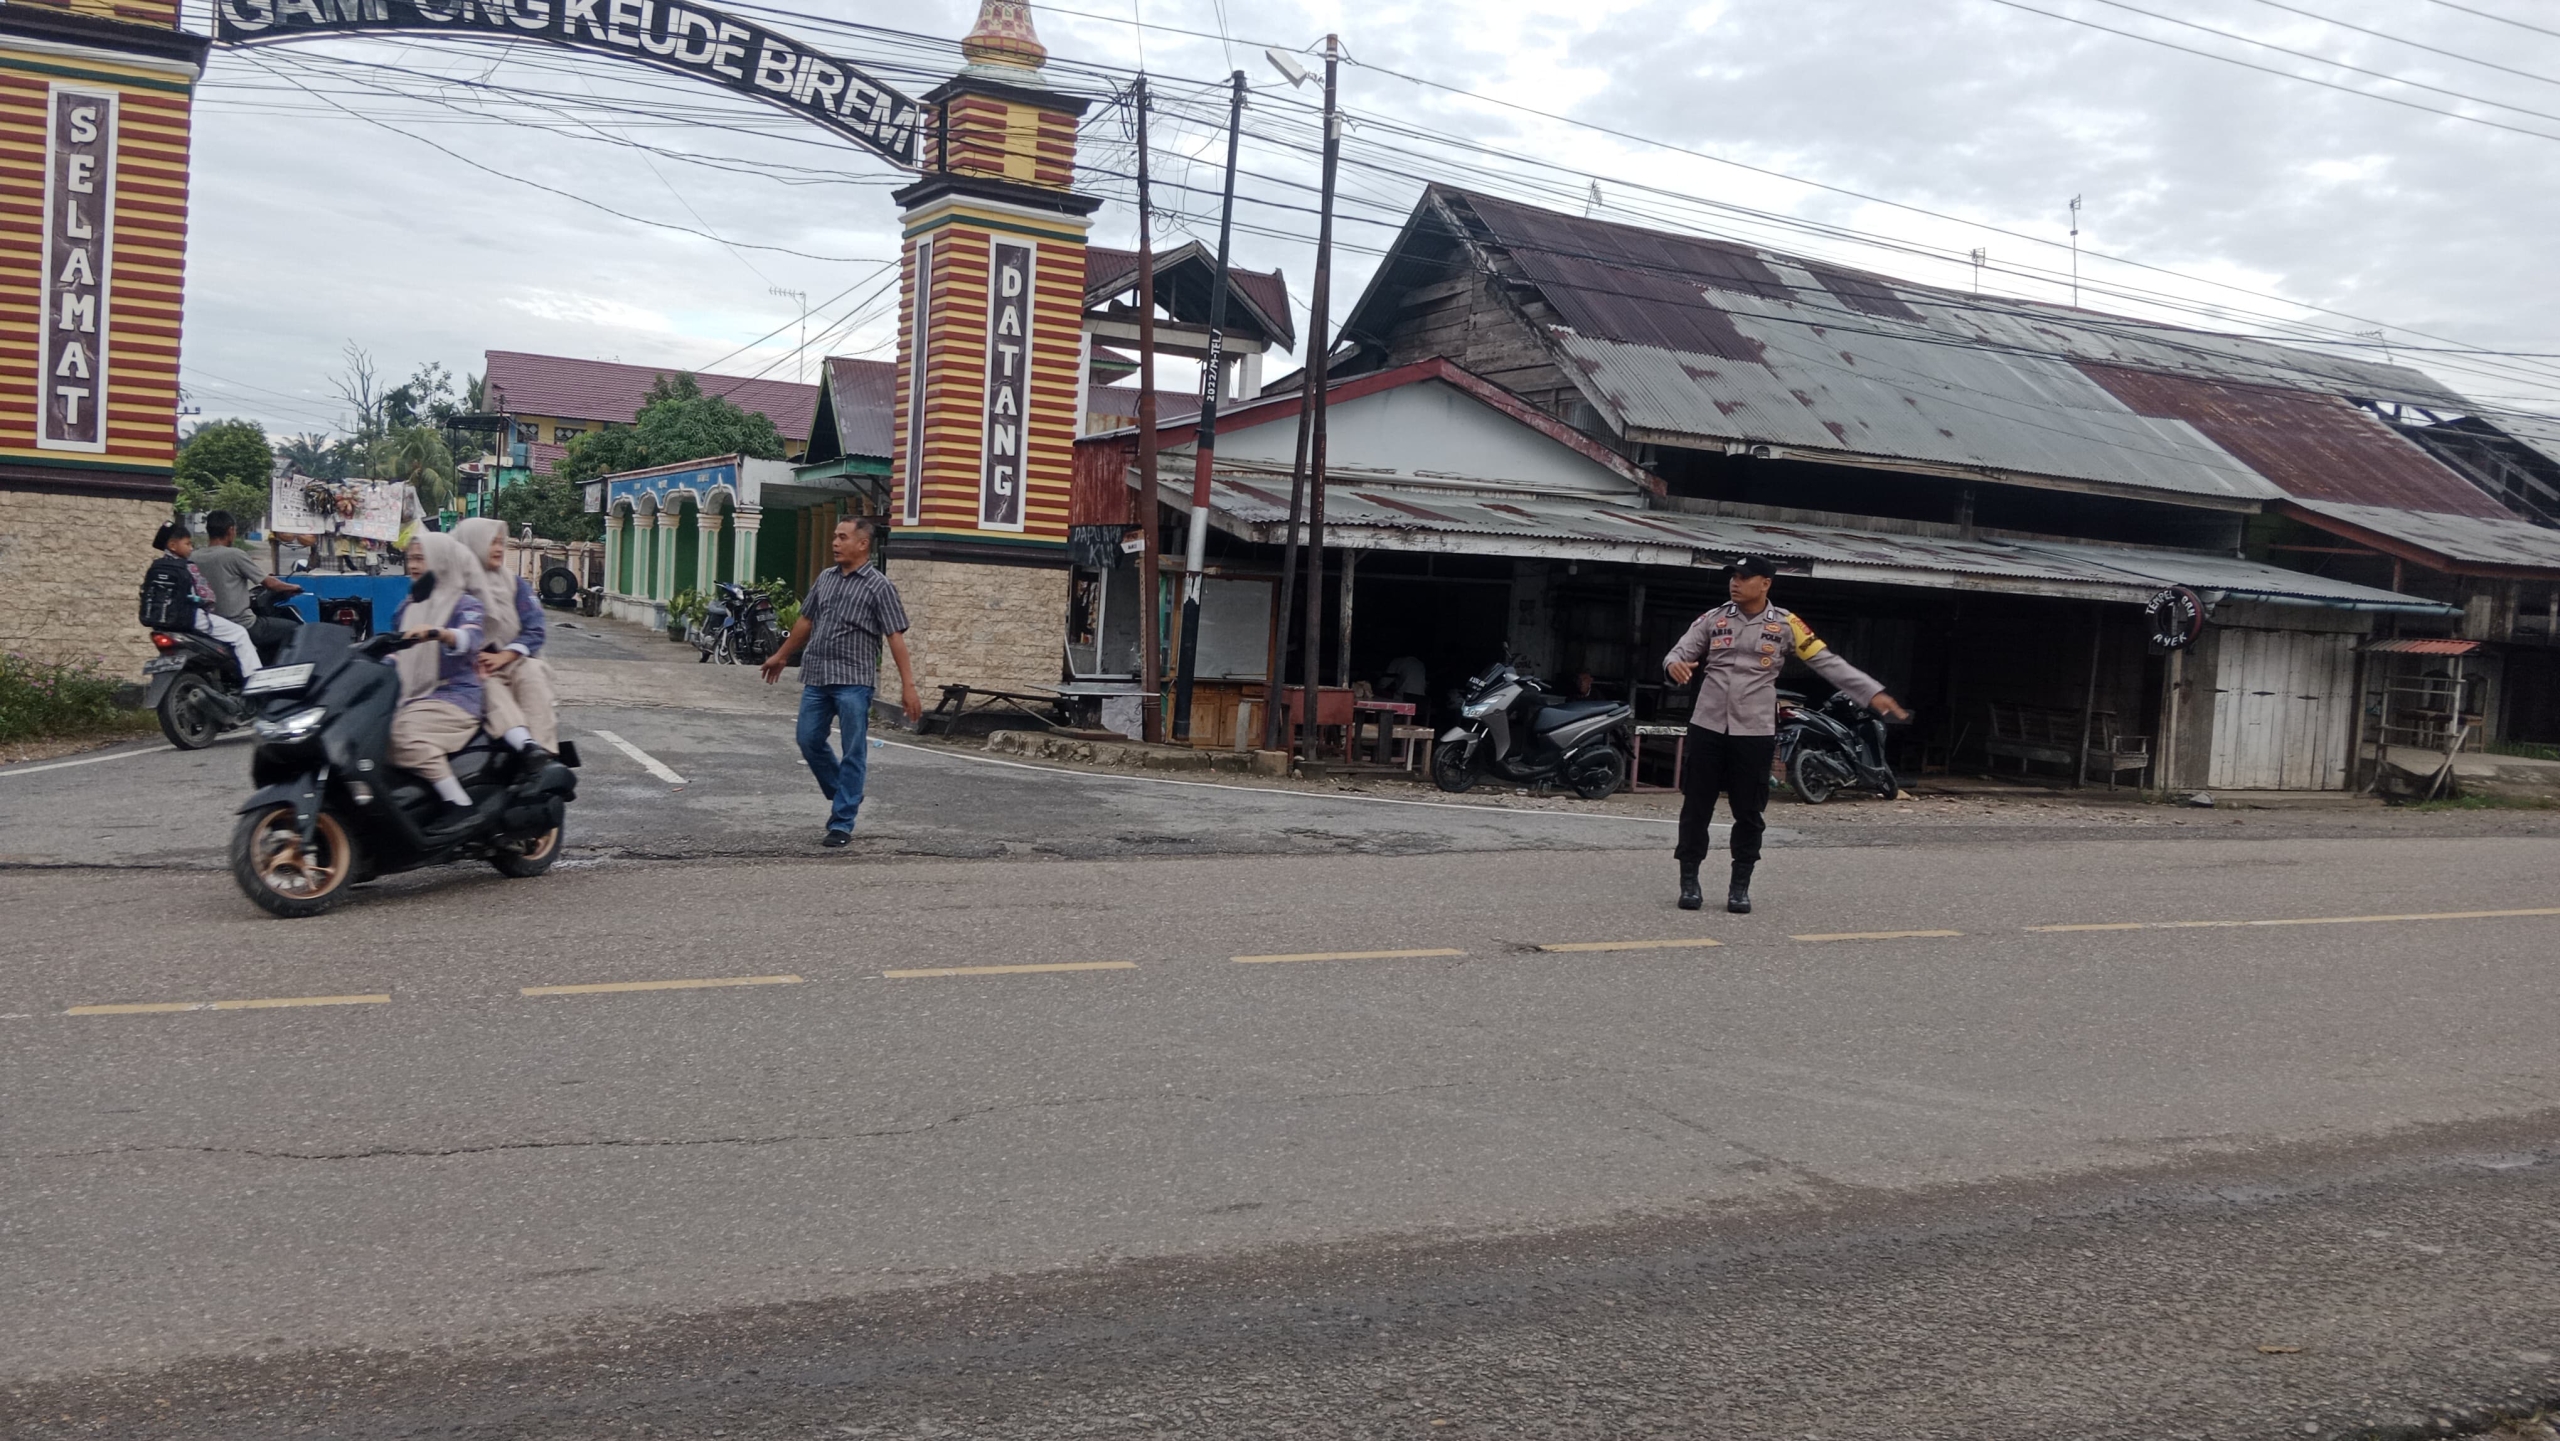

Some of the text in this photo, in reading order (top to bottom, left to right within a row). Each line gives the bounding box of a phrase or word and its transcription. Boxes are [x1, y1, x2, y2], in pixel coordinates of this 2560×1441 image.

[220, 0, 917, 154] GAMONG KEUDE BIREM
[56, 105, 97, 425] SELAMAT
[993, 265, 1023, 497] DATANG
[1206, 328, 1223, 402] 2022/M-TEL/
[2145, 590, 2196, 617] TEMPEL BAN
